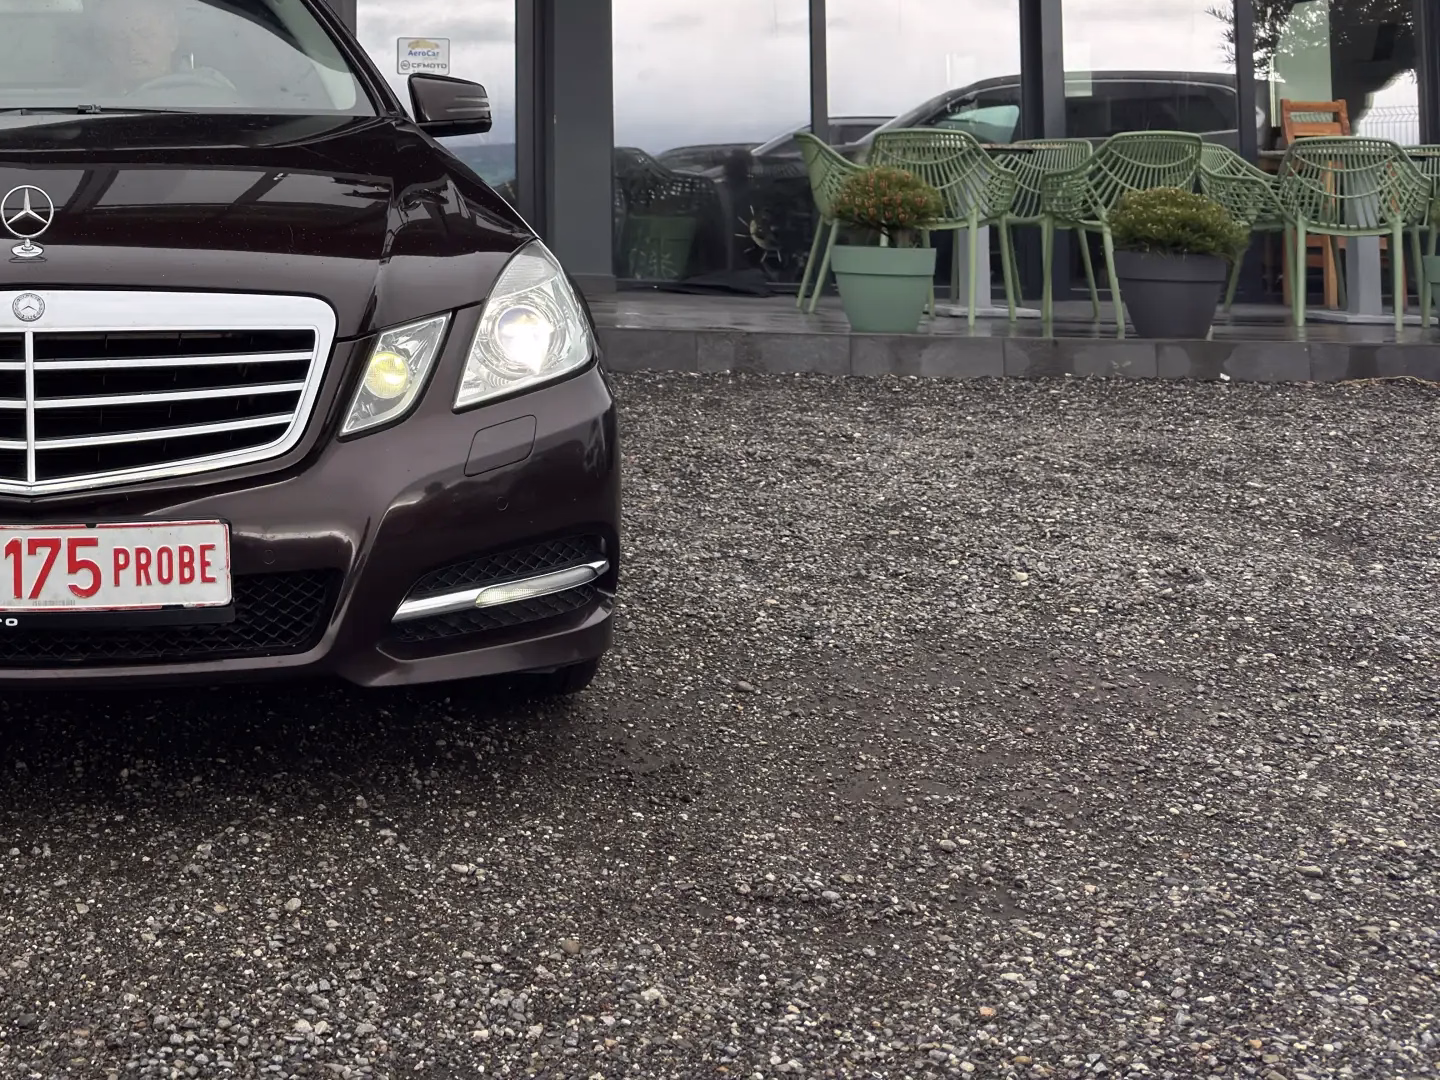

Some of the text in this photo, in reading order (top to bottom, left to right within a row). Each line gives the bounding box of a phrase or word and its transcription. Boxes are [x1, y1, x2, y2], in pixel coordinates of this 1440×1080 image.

[408, 49, 439, 57] AeroCar
[4, 536, 102, 599] 175
[113, 544, 216, 587] PROBE
